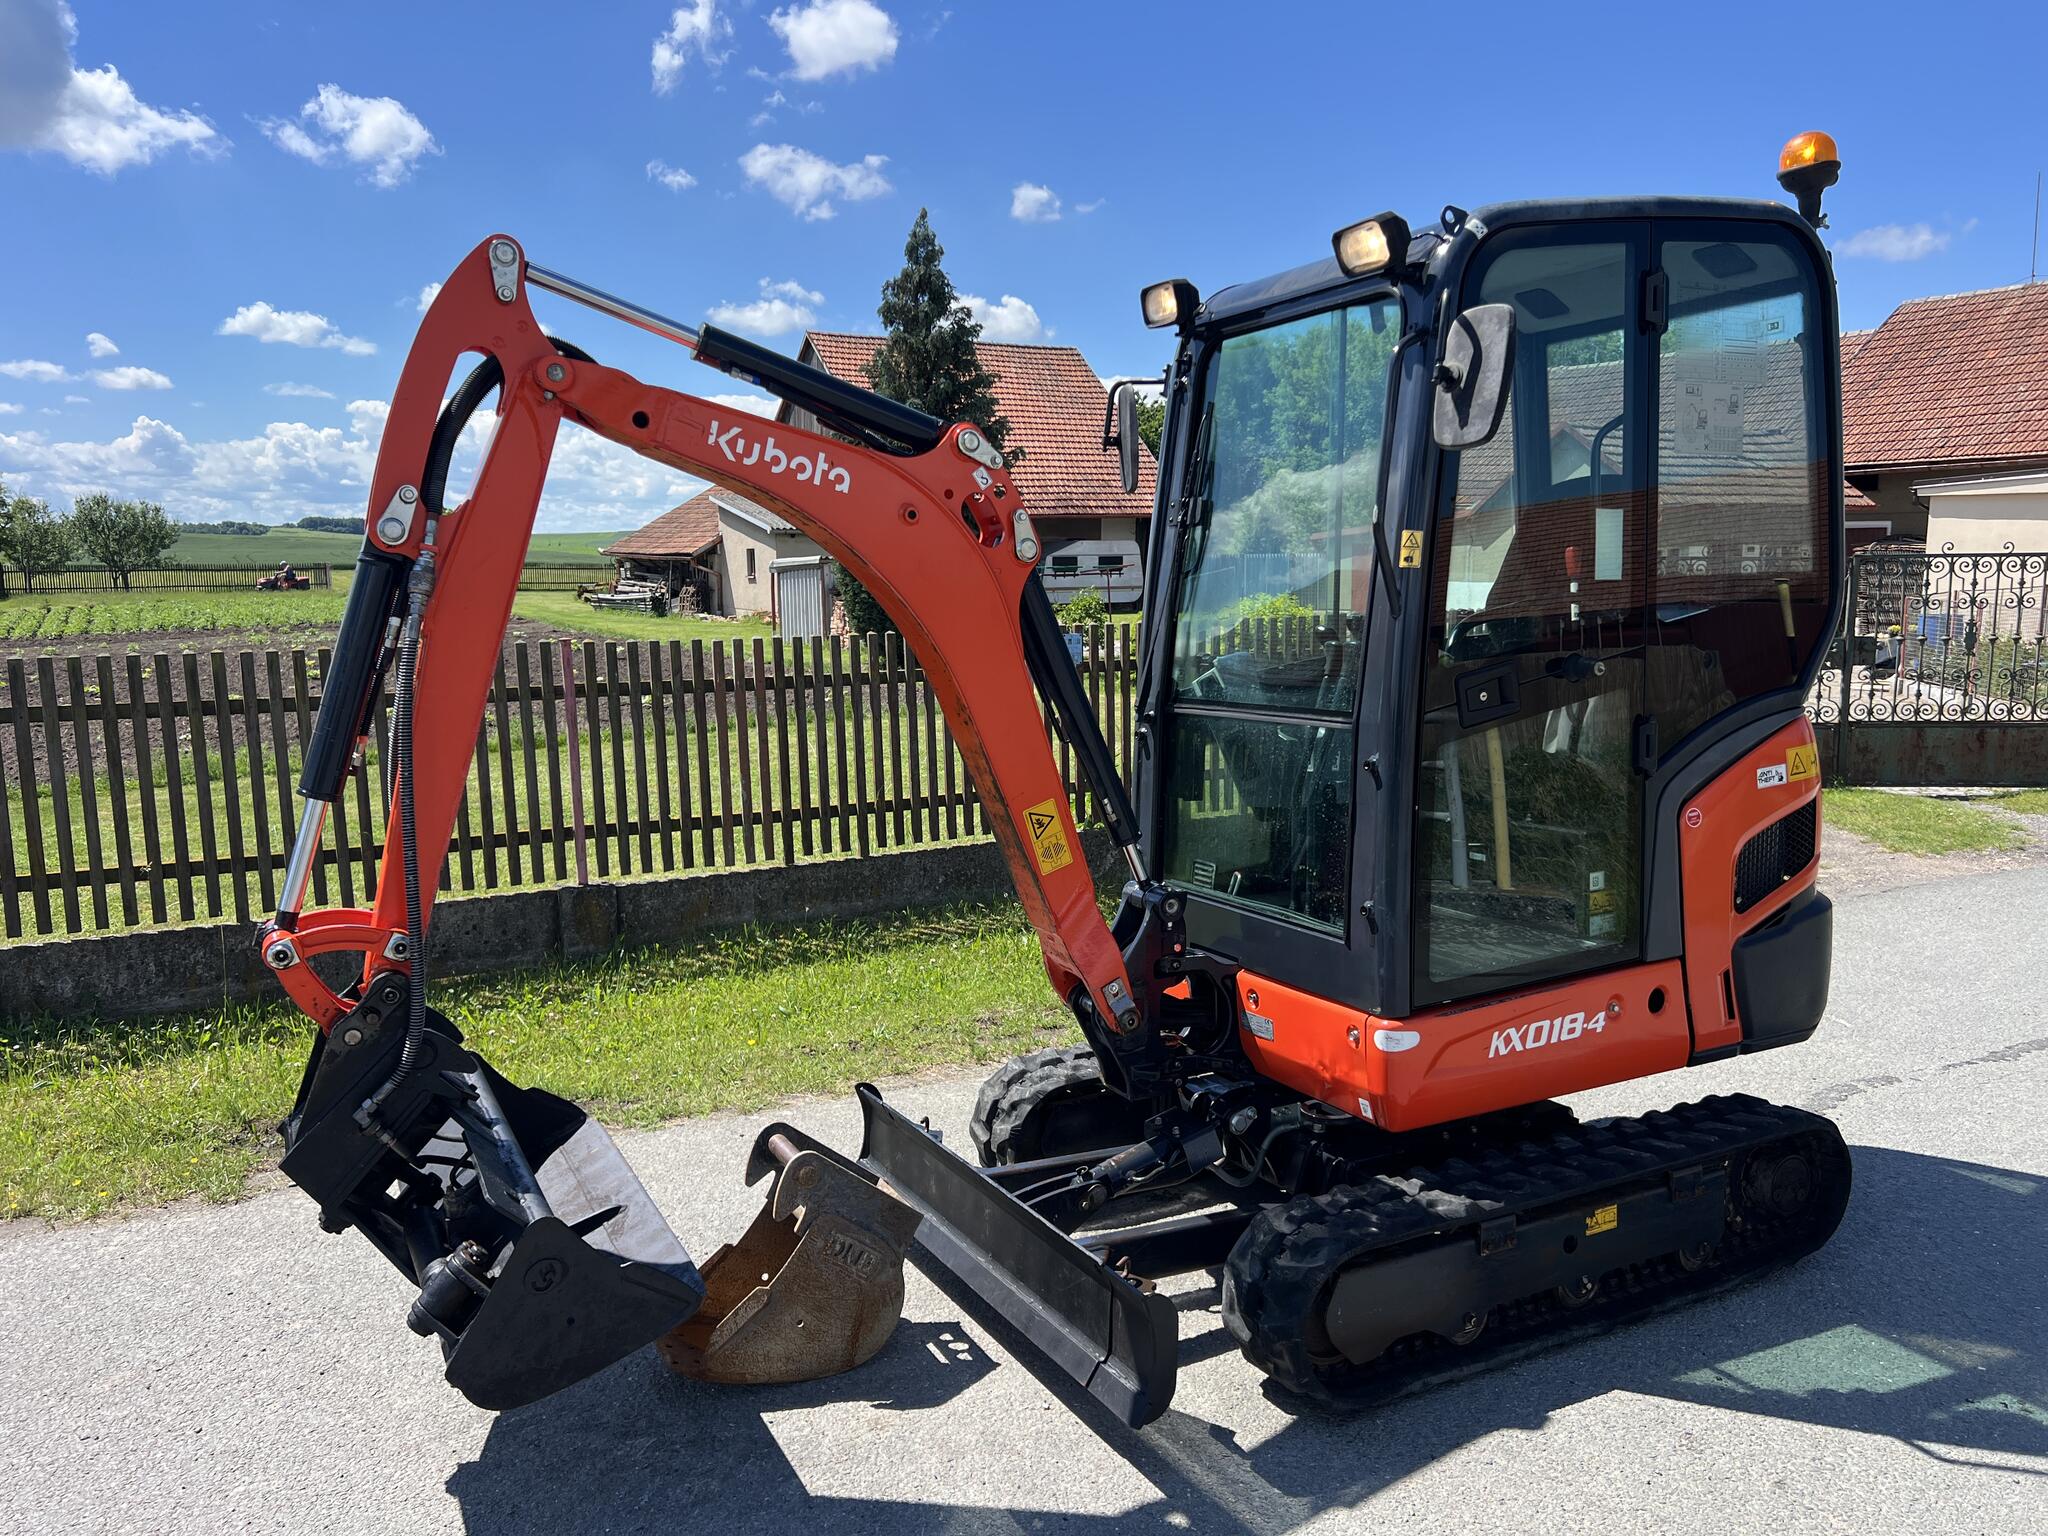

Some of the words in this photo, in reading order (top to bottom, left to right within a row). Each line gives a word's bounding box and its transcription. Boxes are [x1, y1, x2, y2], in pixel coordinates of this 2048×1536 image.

[707, 420, 850, 494] Kubota
[1758, 770, 1773, 778] ANTI
[1758, 775, 1776, 784] THEFT
[1488, 1011, 1606, 1059] KX018-4
